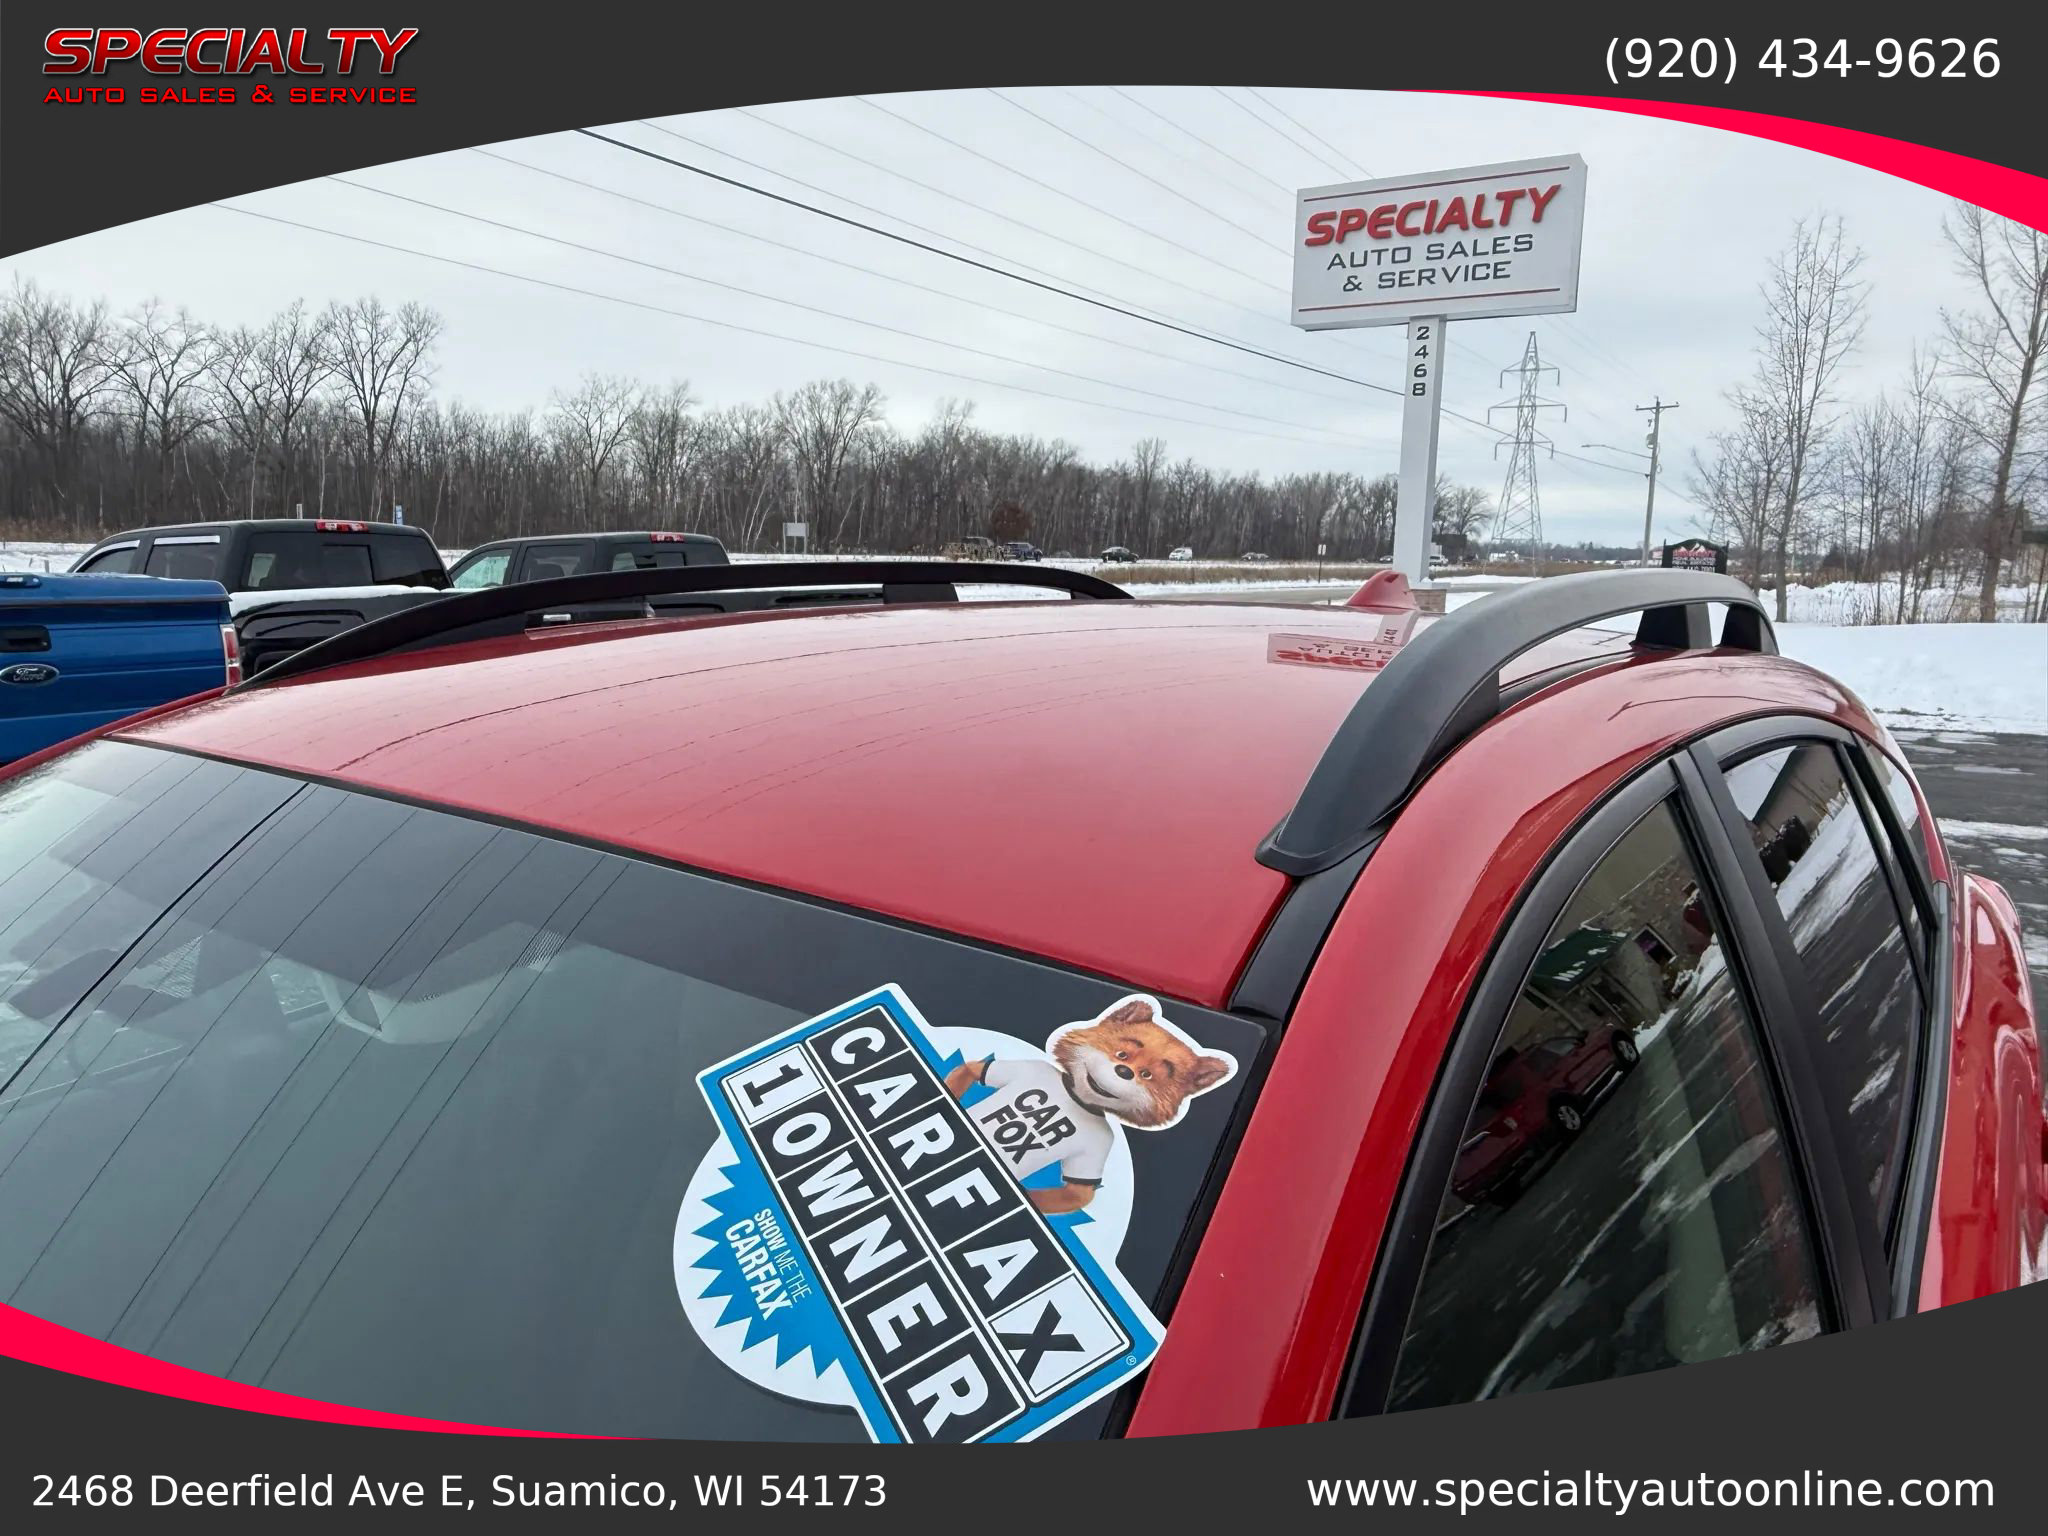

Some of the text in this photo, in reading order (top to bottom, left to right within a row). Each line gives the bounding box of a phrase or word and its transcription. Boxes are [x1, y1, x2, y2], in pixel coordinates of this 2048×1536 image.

[1305, 184, 1562, 247] SPECIALTY
[1326, 233, 1534, 271] AUTO SALES
[1342, 260, 1512, 292] & SERVICE
[1412, 326, 1431, 396] 2468
[980, 1104, 1046, 1165] FOX
[1014, 1088, 1077, 1147] CAR
[830, 1026, 1086, 1383] CARFAX
[725, 1218, 793, 1321] CARFAX
[741, 1064, 989, 1439] 1 OWNER
[753, 1208, 813, 1303] SHOW ME THE
